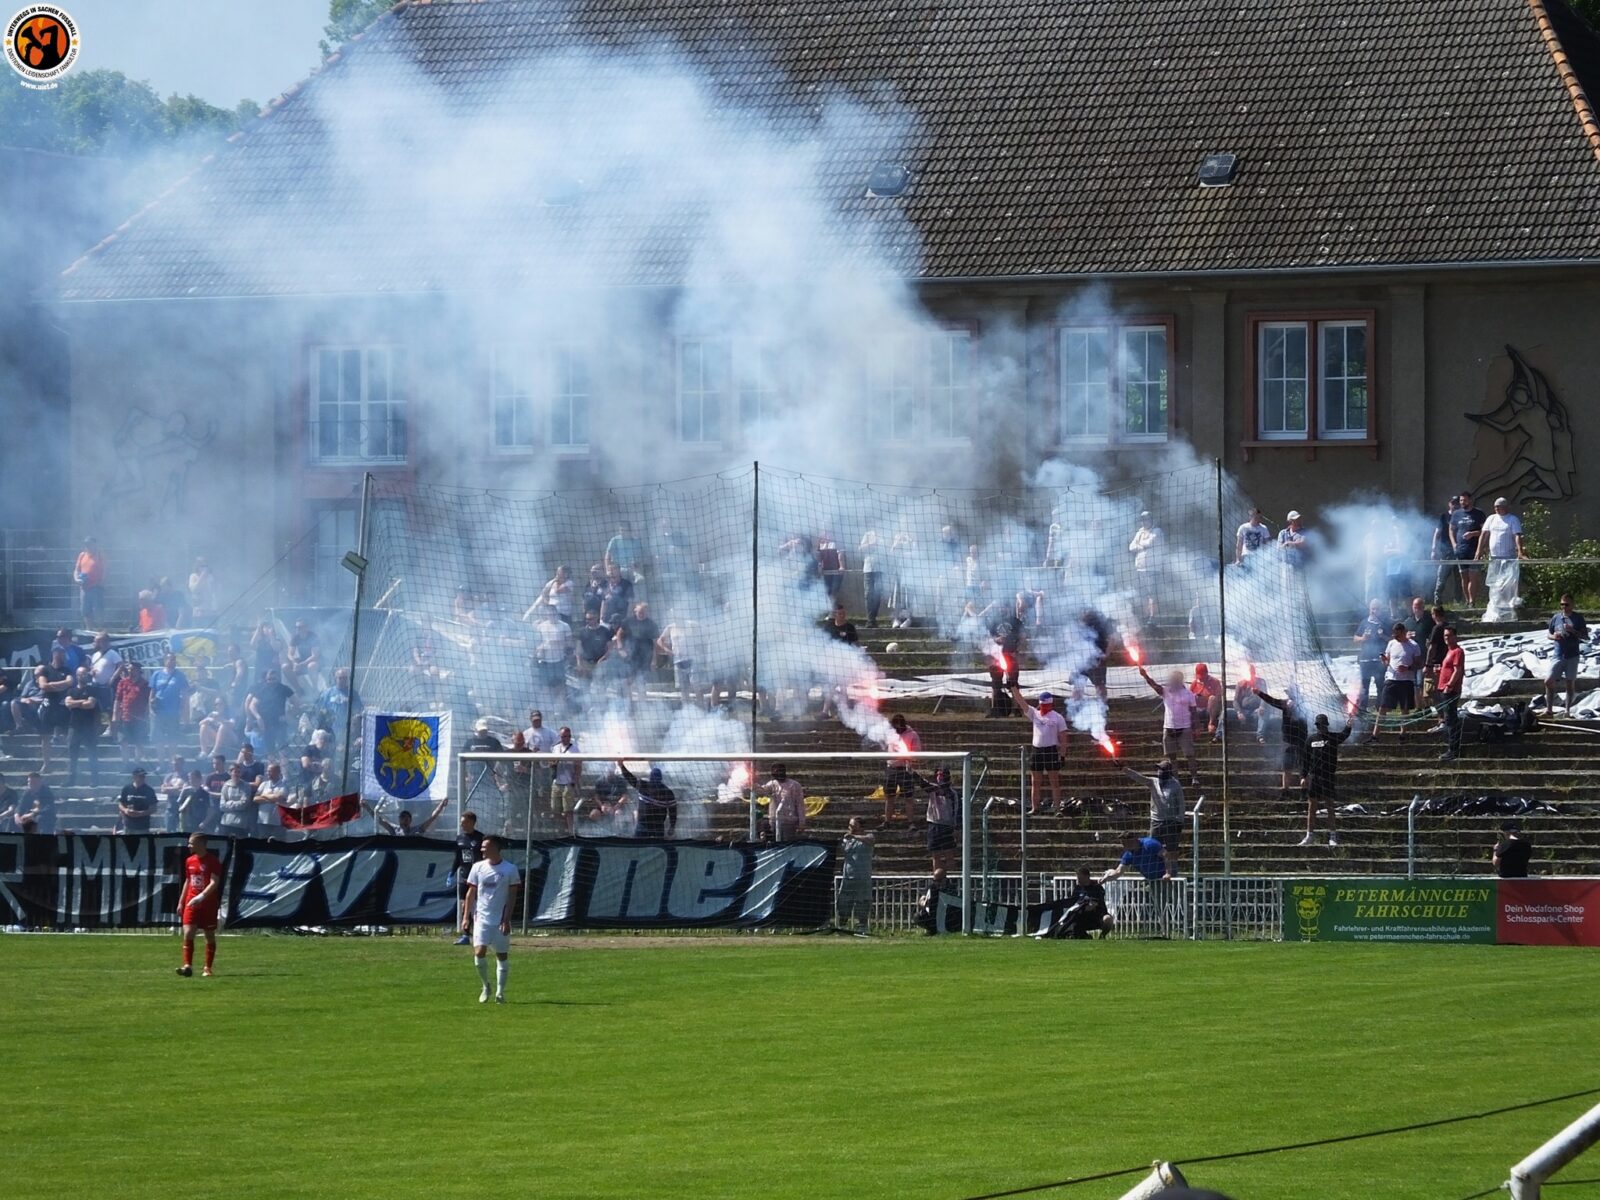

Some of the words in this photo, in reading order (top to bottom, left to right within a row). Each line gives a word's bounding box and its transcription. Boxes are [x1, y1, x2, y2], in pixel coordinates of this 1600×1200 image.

[1334, 886, 1491, 902] PETERMÄNNCHEN
[1354, 904, 1470, 918] FAHRSCHULE
[1504, 904, 1523, 913] Dein
[1524, 904, 1563, 913] Vodafone
[1563, 904, 1585, 914] Shop
[1506, 914, 1584, 924] Schlosspark-Center
[1385, 925, 1457, 933] Kraftfahrerausbildung
[1353, 933, 1471, 941] www.petermaennchen-fahrschule.de
